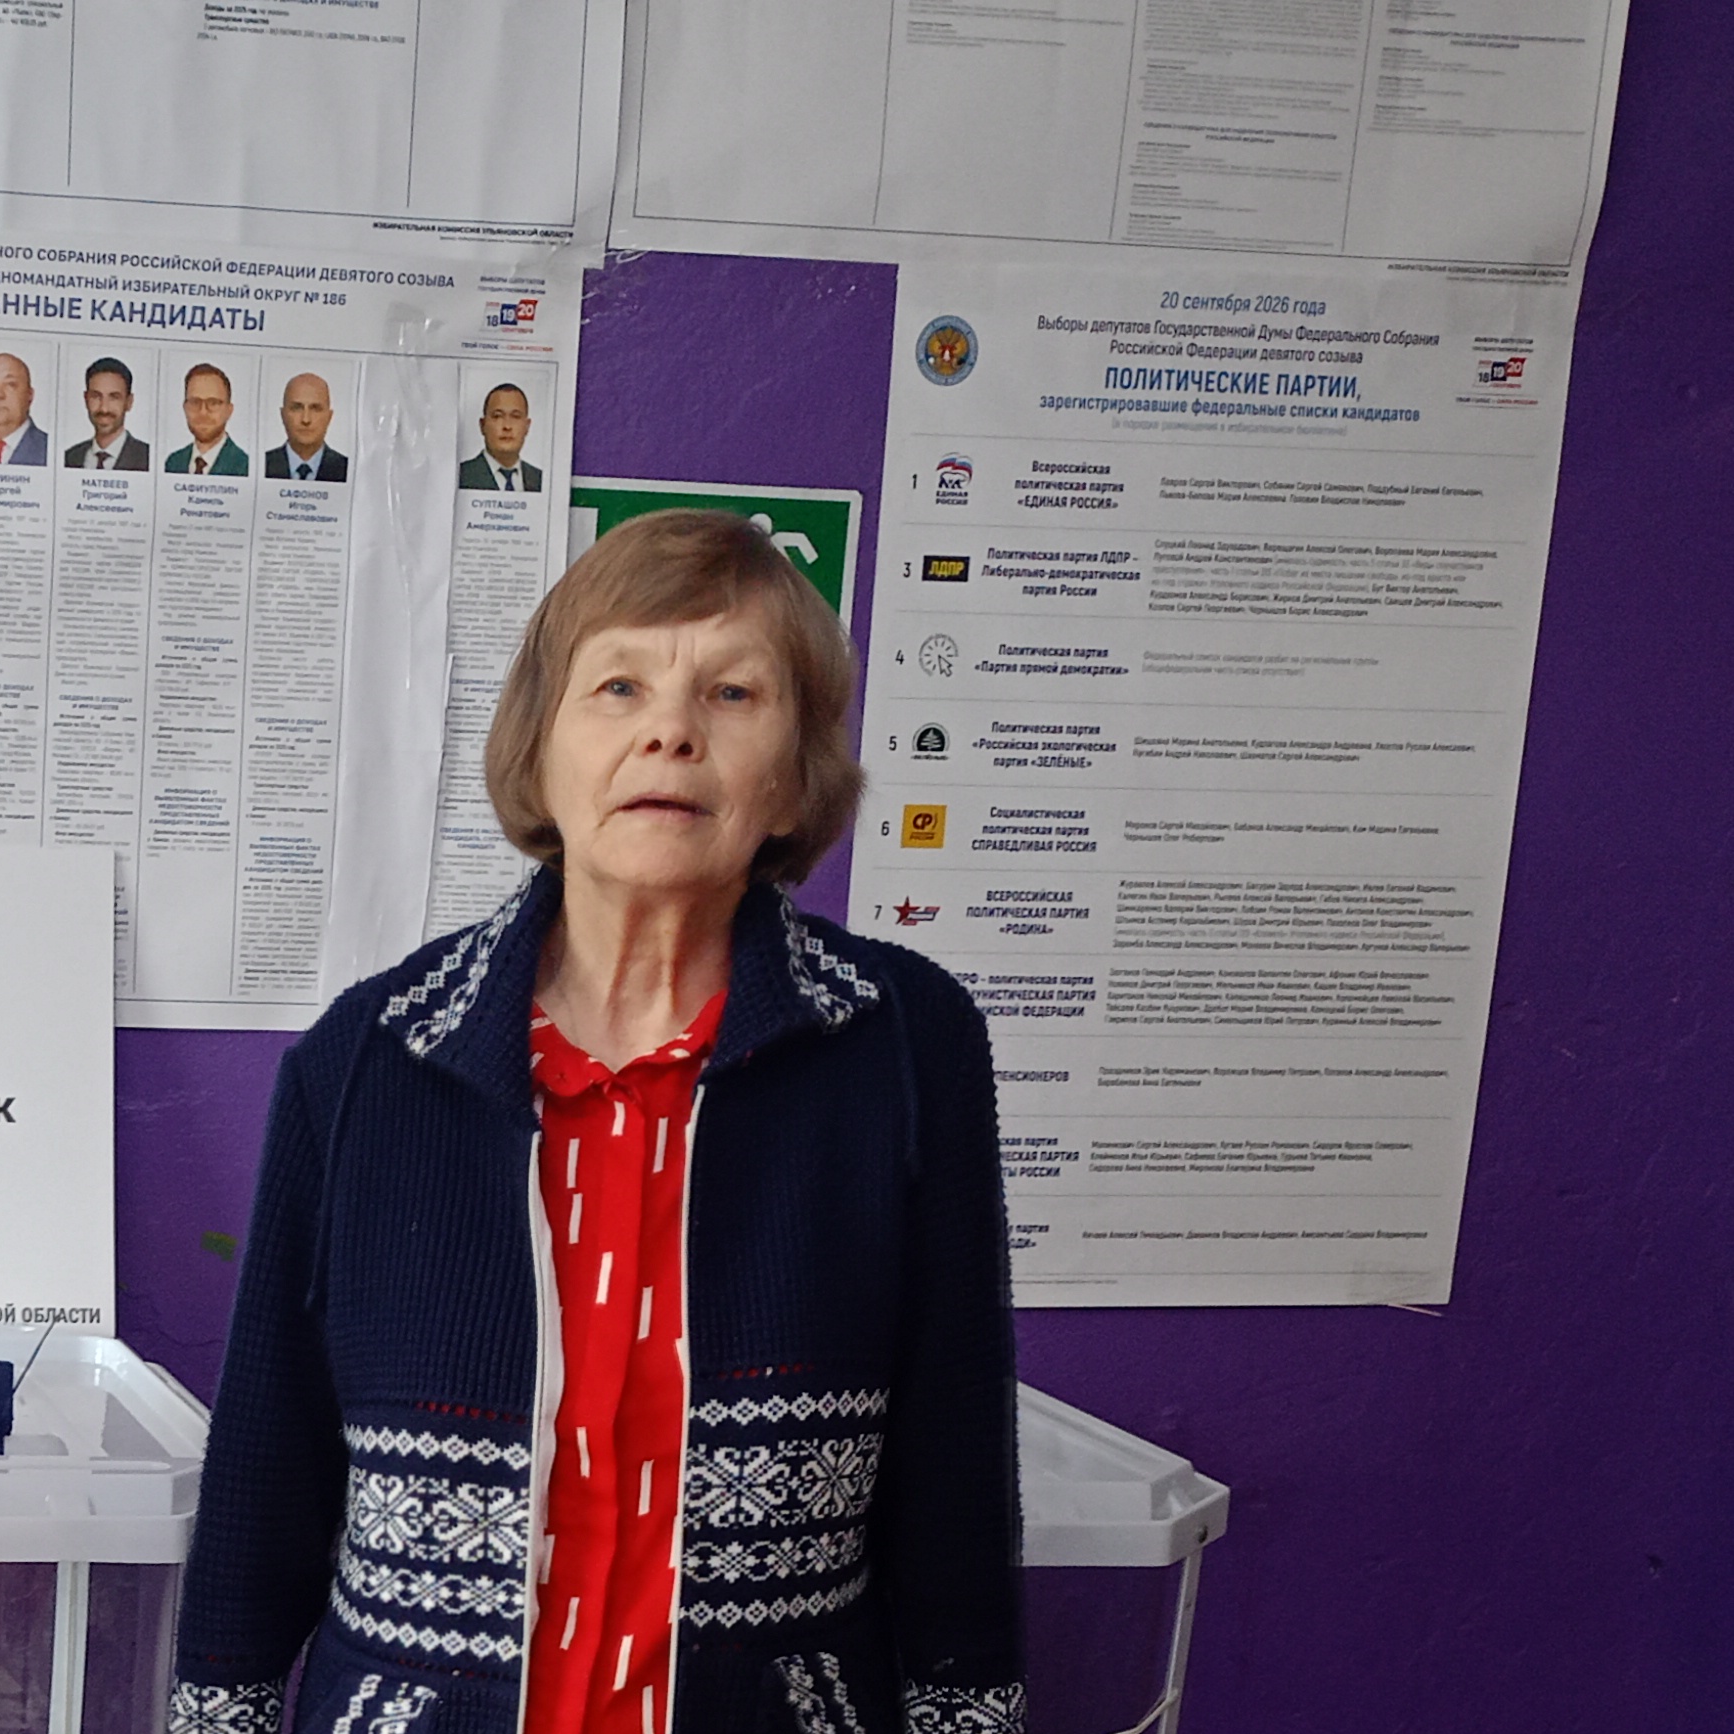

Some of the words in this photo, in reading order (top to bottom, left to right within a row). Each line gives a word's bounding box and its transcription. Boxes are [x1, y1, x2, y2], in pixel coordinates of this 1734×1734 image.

[37, 248, 116, 266] СОБРАНИЯ
[120, 254, 222, 273] РОССИЙСКОЙ
[226, 261, 316, 280] ФЕДЕРАЦИИ
[319, 267, 394, 285] ДЕВЯТОГО
[397, 272, 455, 288] СОЗЫВА
[122, 279, 250, 299] ИЗБИРАТЕЛЬНЫЙ
[254, 288, 301, 304] ОКРУГ
[303, 291, 320, 304] №
[323, 291, 347, 305] 186
[1160, 291, 1179, 309] 20
[1182, 293, 1251, 316] сентября
[1254, 295, 1290, 314] 2026
[1293, 301, 1326, 317] года
[90, 298, 265, 331] КАНДИДАТЫ
[486, 315, 498, 327] 18
[502, 309, 516, 322] 19
[517, 303, 534, 317] 20
[1037, 314, 1088, 333] Выборы
[1090, 320, 1151, 336] депутатов
[1153, 319, 1255, 340] Государственной
[1257, 324, 1293, 342] Думы
[1295, 326, 1380, 345] Федерального
[1383, 329, 1440, 348] Собрания
[1109, 339, 1183, 357] Российской
[1186, 342, 1257, 361] Федерации
[1259, 347, 1315, 363] девятого
[1318, 349, 1363, 364] созыва
[1104, 366, 1271, 395] ПОЛИТИЧЕСКИЕ
[1276, 373, 1362, 401] ПАРТИИ,
[1039, 395, 1187, 414] зарегистрировавшие
[1191, 398, 1286, 417] федеральные
[1290, 404, 1338, 420] списки
[1342, 406, 1420, 423] кандидатов
[1032, 460, 1111, 475] Всероссийская
[81, 478, 129, 489] МАТВЕЕВ
[912, 474, 918, 489] 1
[1014, 479, 1086, 491] политическая
[1089, 482, 1124, 493] партия
[82, 490, 127, 501] Григорий
[174, 483, 238, 495] САФИУЛЛИН
[279, 488, 329, 500] САФОНОВ
[76, 502, 134, 513] Алексеевич
[288, 501, 318, 512] Игорь
[1017, 495, 1067, 508] «ЕДИНАЯ
[1070, 496, 1118, 509] РОССИЯ»
[180, 507, 230, 519] Ренатович
[266, 511, 338, 524] Станиславович
[483, 511, 514, 521] Роман
[987, 548, 1060, 561] Политическая
[1063, 551, 1098, 564] партия
[1100, 552, 1131, 564] ЛДПР
[903, 562, 912, 578] 3
[929, 560, 965, 578] ЛДПР
[981, 565, 1141, 581] Либерально-демократическая
[1022, 585, 1057, 596] партия
[1059, 584, 1098, 597] России
[895, 650, 904, 665] 4
[998, 644, 1071, 658] Политическая
[1074, 647, 1109, 659] партия
[974, 660, 1017, 674] «Партия
[1020, 661, 1059, 674] прямой
[1060, 664, 1130, 676] демократии»
[991, 721, 1063, 735] Политическая
[1066, 725, 1101, 737] партия
[889, 736, 897, 751] 5
[972, 738, 1038, 751] «Российская
[1041, 741, 1117, 752] экологическая
[993, 757, 1028, 769] партия
[1030, 755, 1093, 768] «ЗЕЛЁНЫЕ»
[990, 806, 1085, 820] Социалистическая
[881, 820, 890, 836] 6
[982, 824, 1052, 835] политическая
[1055, 825, 1089, 837] партия
[971, 839, 1053, 852] СПРАВЕДЛИВАЯ
[1056, 841, 1097, 852] РОССИЯ
[986, 888, 1073, 902] ВСЕРОССИЙСКАЯ
[874, 905, 882, 920] 7
[966, 906, 1047, 918] ПОЛИТИЧЕСКАЯ
[1049, 907, 1090, 919] ПАРТИЯ
[999, 924, 1054, 935] «РОДИНА»
[953, 972, 979, 985] ПРФ
[988, 974, 1057, 985] политическая
[1059, 976, 1094, 987] партия
[970, 990, 1054, 1001] УНИСТИЧЕСКАЯ
[1056, 990, 1096, 1001] ПАРТИЯ
[1022, 1005, 1085, 1017] ФЕДЕРАЦИИ
[995, 1071, 1069, 1082] ПЕНСИОНЕРОВ
[1024, 1137, 1058, 1147] партия
[1040, 1151, 1079, 1162] ПАРТИЯ
[1019, 1166, 1060, 1177] РОССИИ
[1016, 1225, 1049, 1235] партия
[22, 1306, 102, 1325] ОБЛАСТИ
